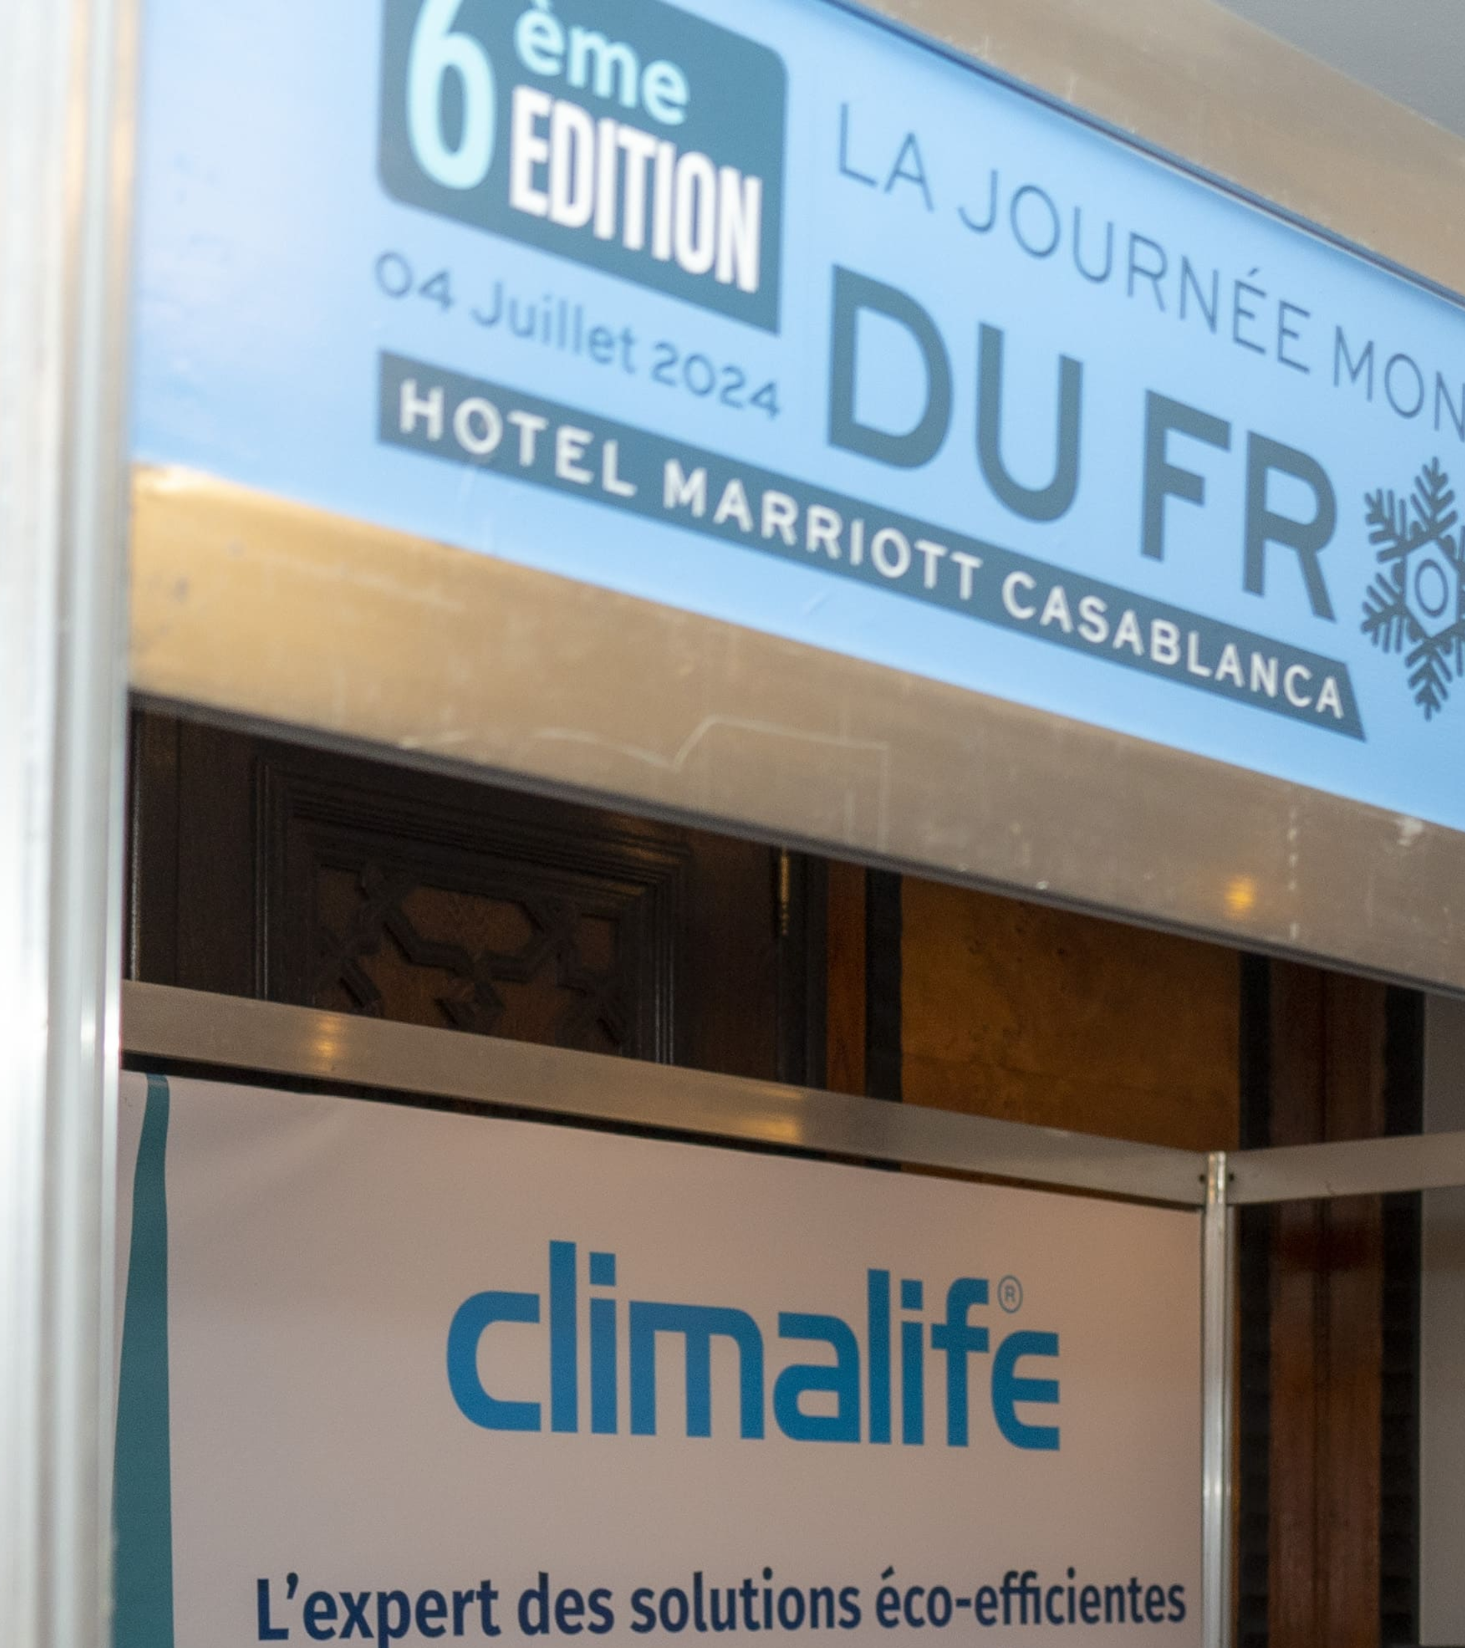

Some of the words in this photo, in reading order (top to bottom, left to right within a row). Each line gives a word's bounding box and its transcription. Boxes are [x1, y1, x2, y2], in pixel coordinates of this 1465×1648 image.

[405, 0, 497, 190] 6
[508, 84, 763, 293] EDITION
[374, 249, 456, 314] 04
[471, 280, 638, 375] Juillet
[649, 341, 781, 421] 2024
[837, 102, 934, 213] LA
[958, 168, 1311, 375] JOURNÉE
[827, 262, 1084, 524] DU
[399, 377, 638, 499] HOTEL
[663, 457, 983, 602] MARRIOTT
[1001, 570, 1346, 720] CASABLANCA
[516, 1571, 615, 1637] des
[628, 1567, 862, 1635] solutions
[874, 1564, 1188, 1631] éco-efficientes
